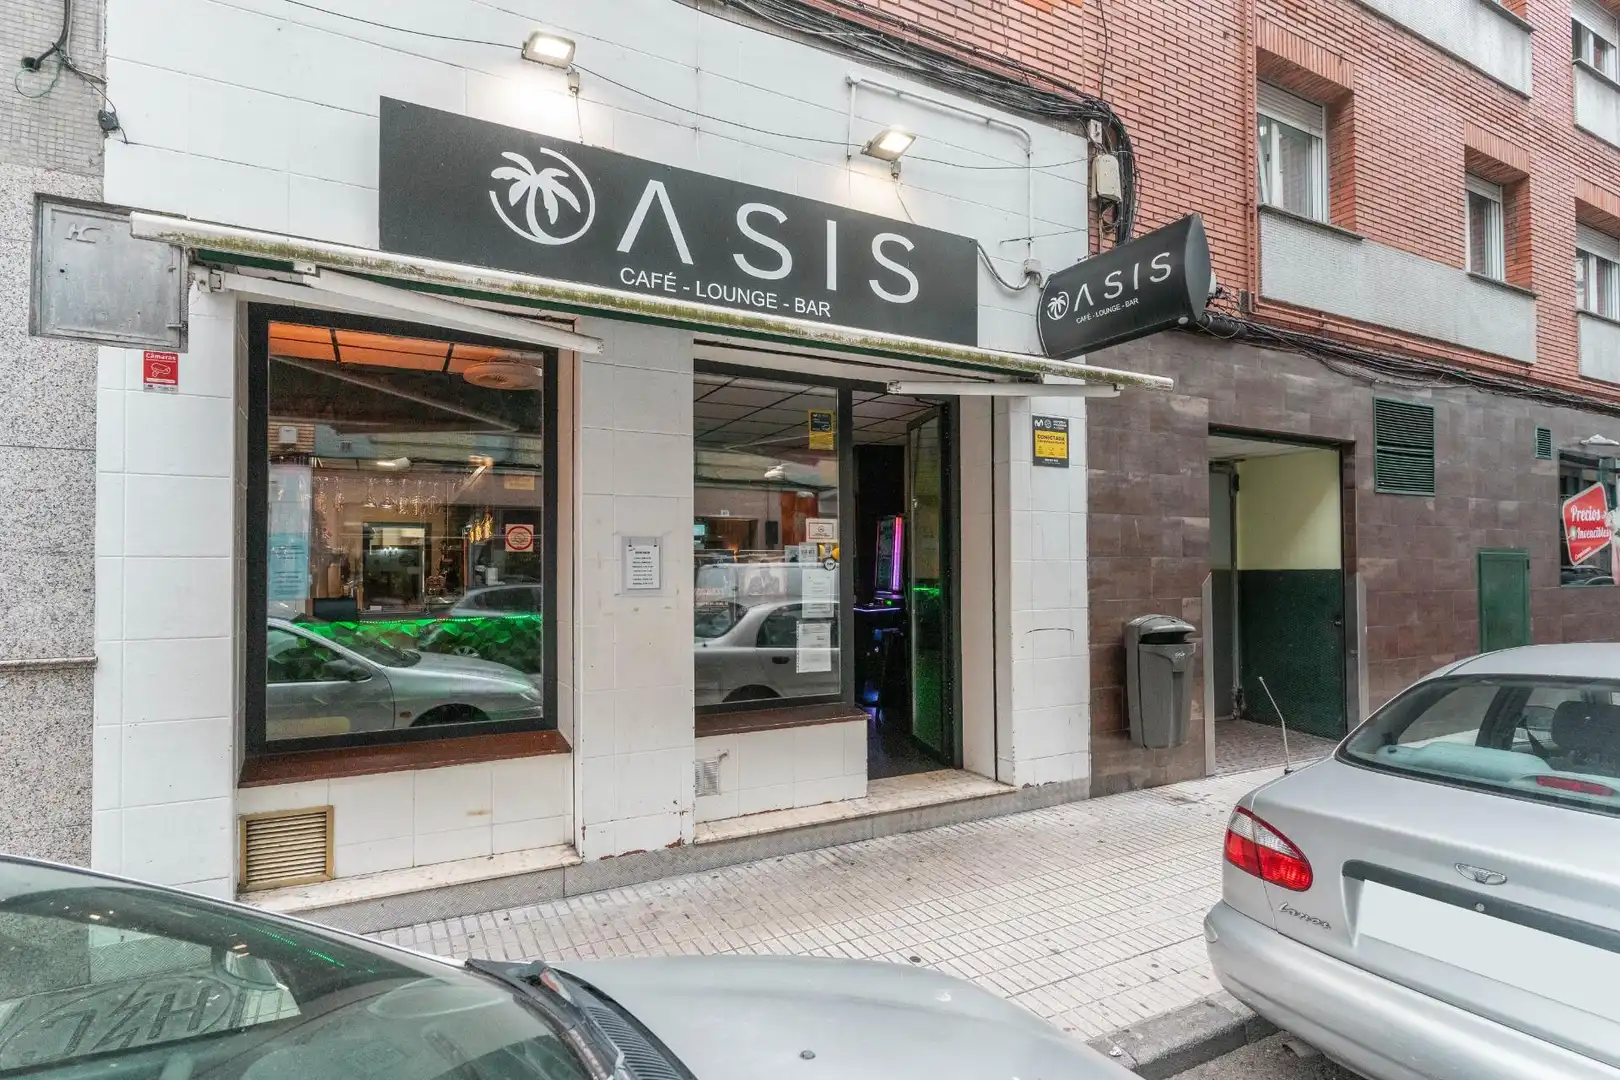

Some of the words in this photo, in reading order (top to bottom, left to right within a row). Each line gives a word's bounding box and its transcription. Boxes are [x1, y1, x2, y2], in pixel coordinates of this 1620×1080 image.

[619, 267, 677, 293] CAFÉ
[696, 280, 778, 310] LOUNGE
[794, 297, 831, 318] BAR
[1075, 312, 1092, 324] CAFÉ
[1095, 303, 1121, 318] LOUNGE
[1124, 297, 1139, 309] BAR
[1570, 504, 1601, 522] Precios
[1278, 901, 1332, 931] Lanos
